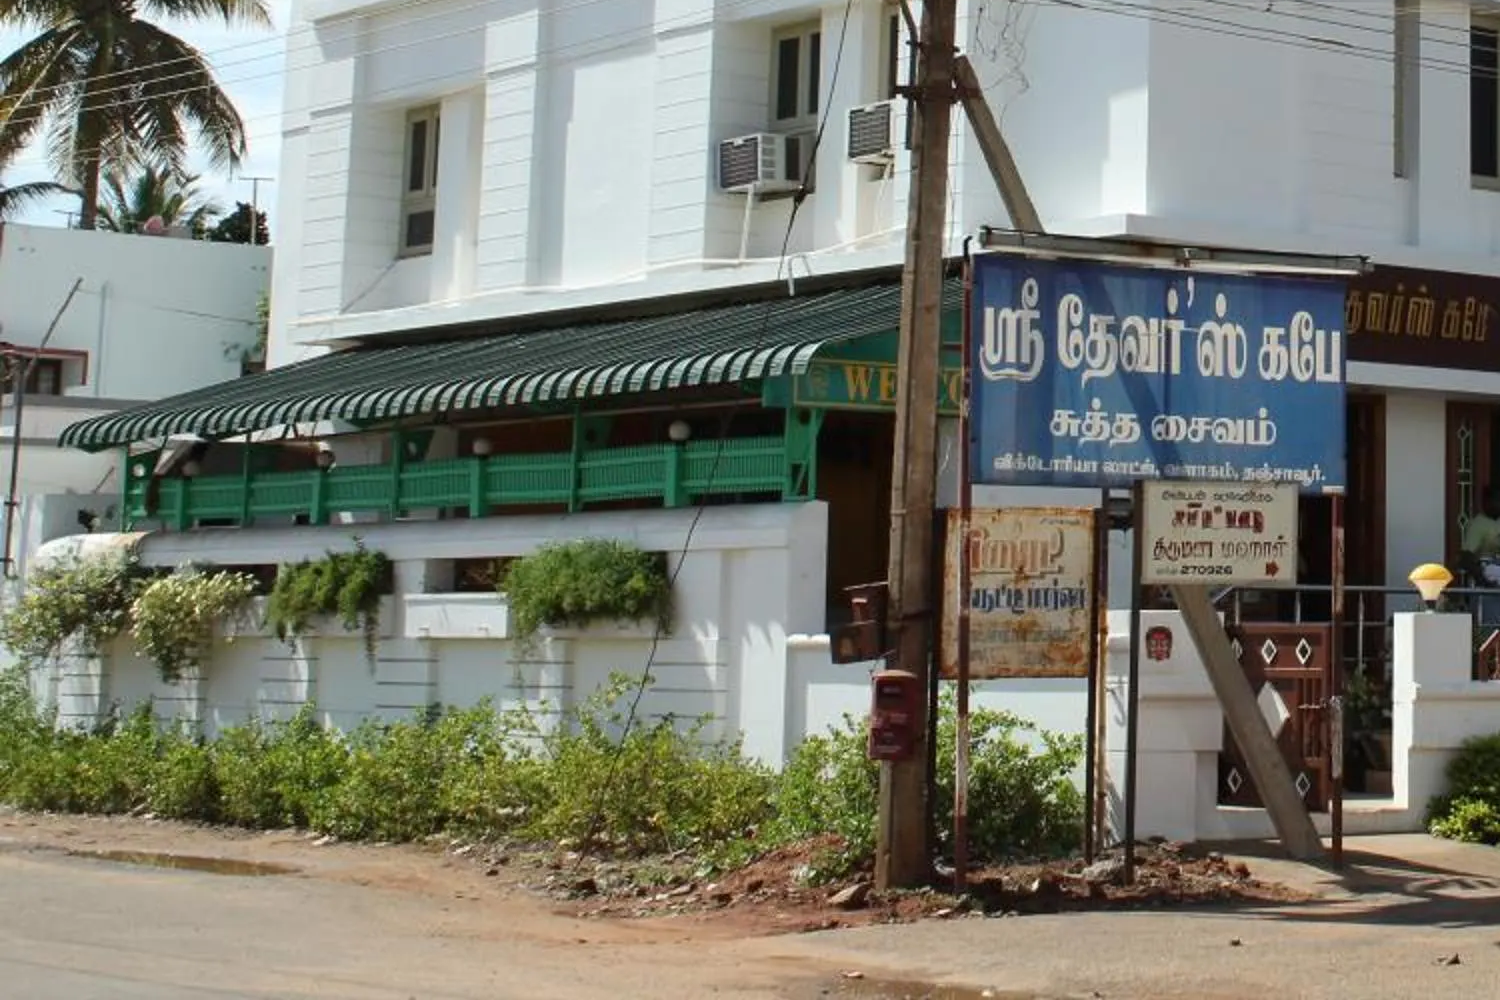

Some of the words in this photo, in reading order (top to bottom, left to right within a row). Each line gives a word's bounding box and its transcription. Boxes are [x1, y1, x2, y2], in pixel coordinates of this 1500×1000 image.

[1258, 311, 1341, 383] கபே
[1050, 397, 1140, 447] சுத்த
[1151, 406, 1277, 446] சைவம்
